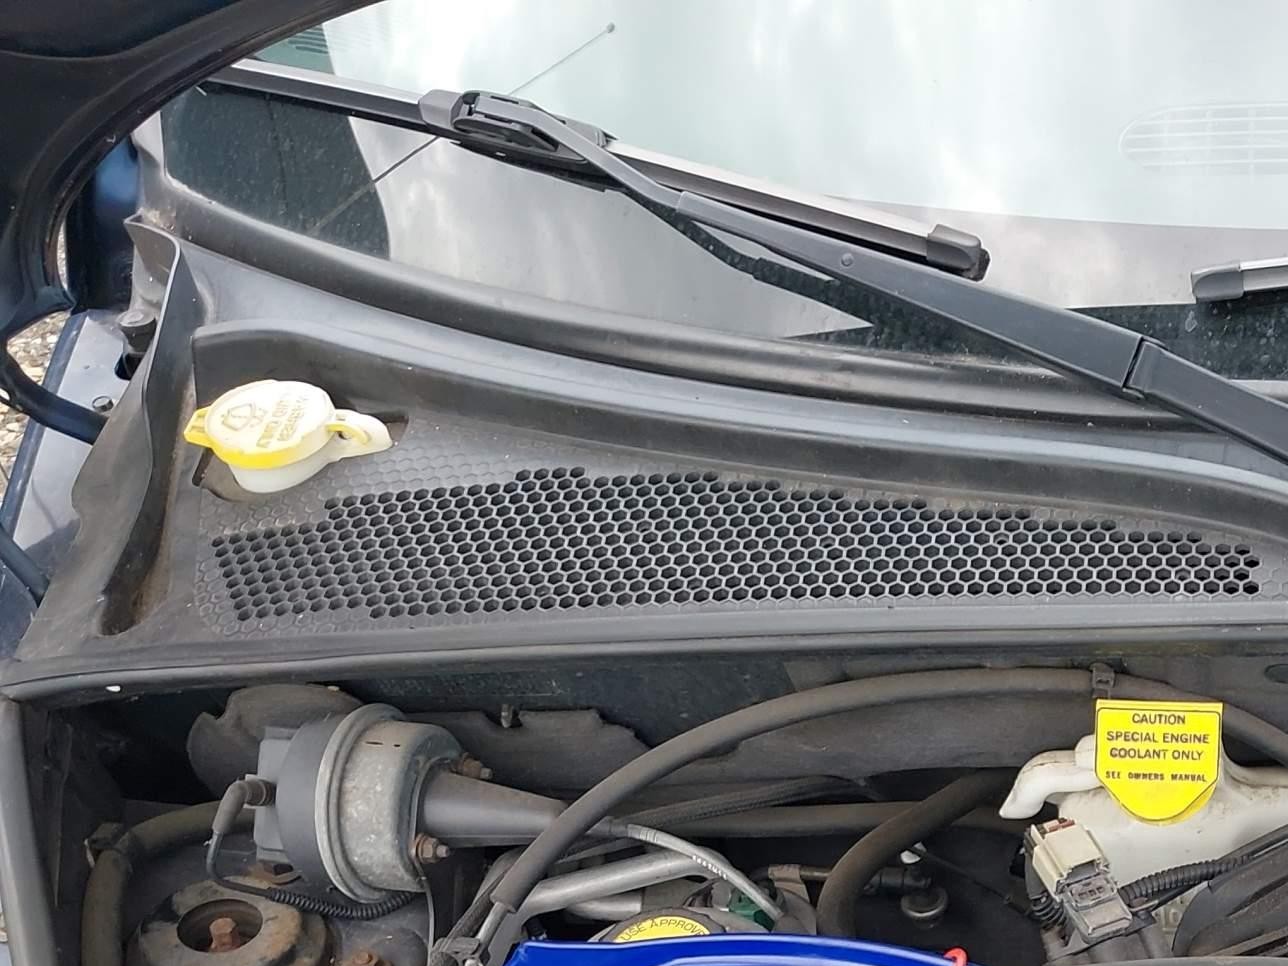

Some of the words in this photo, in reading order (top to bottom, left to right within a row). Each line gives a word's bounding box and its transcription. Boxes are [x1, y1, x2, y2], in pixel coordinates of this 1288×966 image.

[1131, 713, 1186, 725] CAUTION
[1106, 730, 1159, 743] SPECIAL
[1162, 732, 1210, 744] ENGINE
[1109, 747, 1168, 760] COOLANT
[1171, 749, 1204, 761] ONLY
[1105, 770, 1121, 780] SEE
[1127, 771, 1165, 781] OWNERS
[1170, 773, 1207, 783] MANUAL
[620, 923, 648, 942] USE
